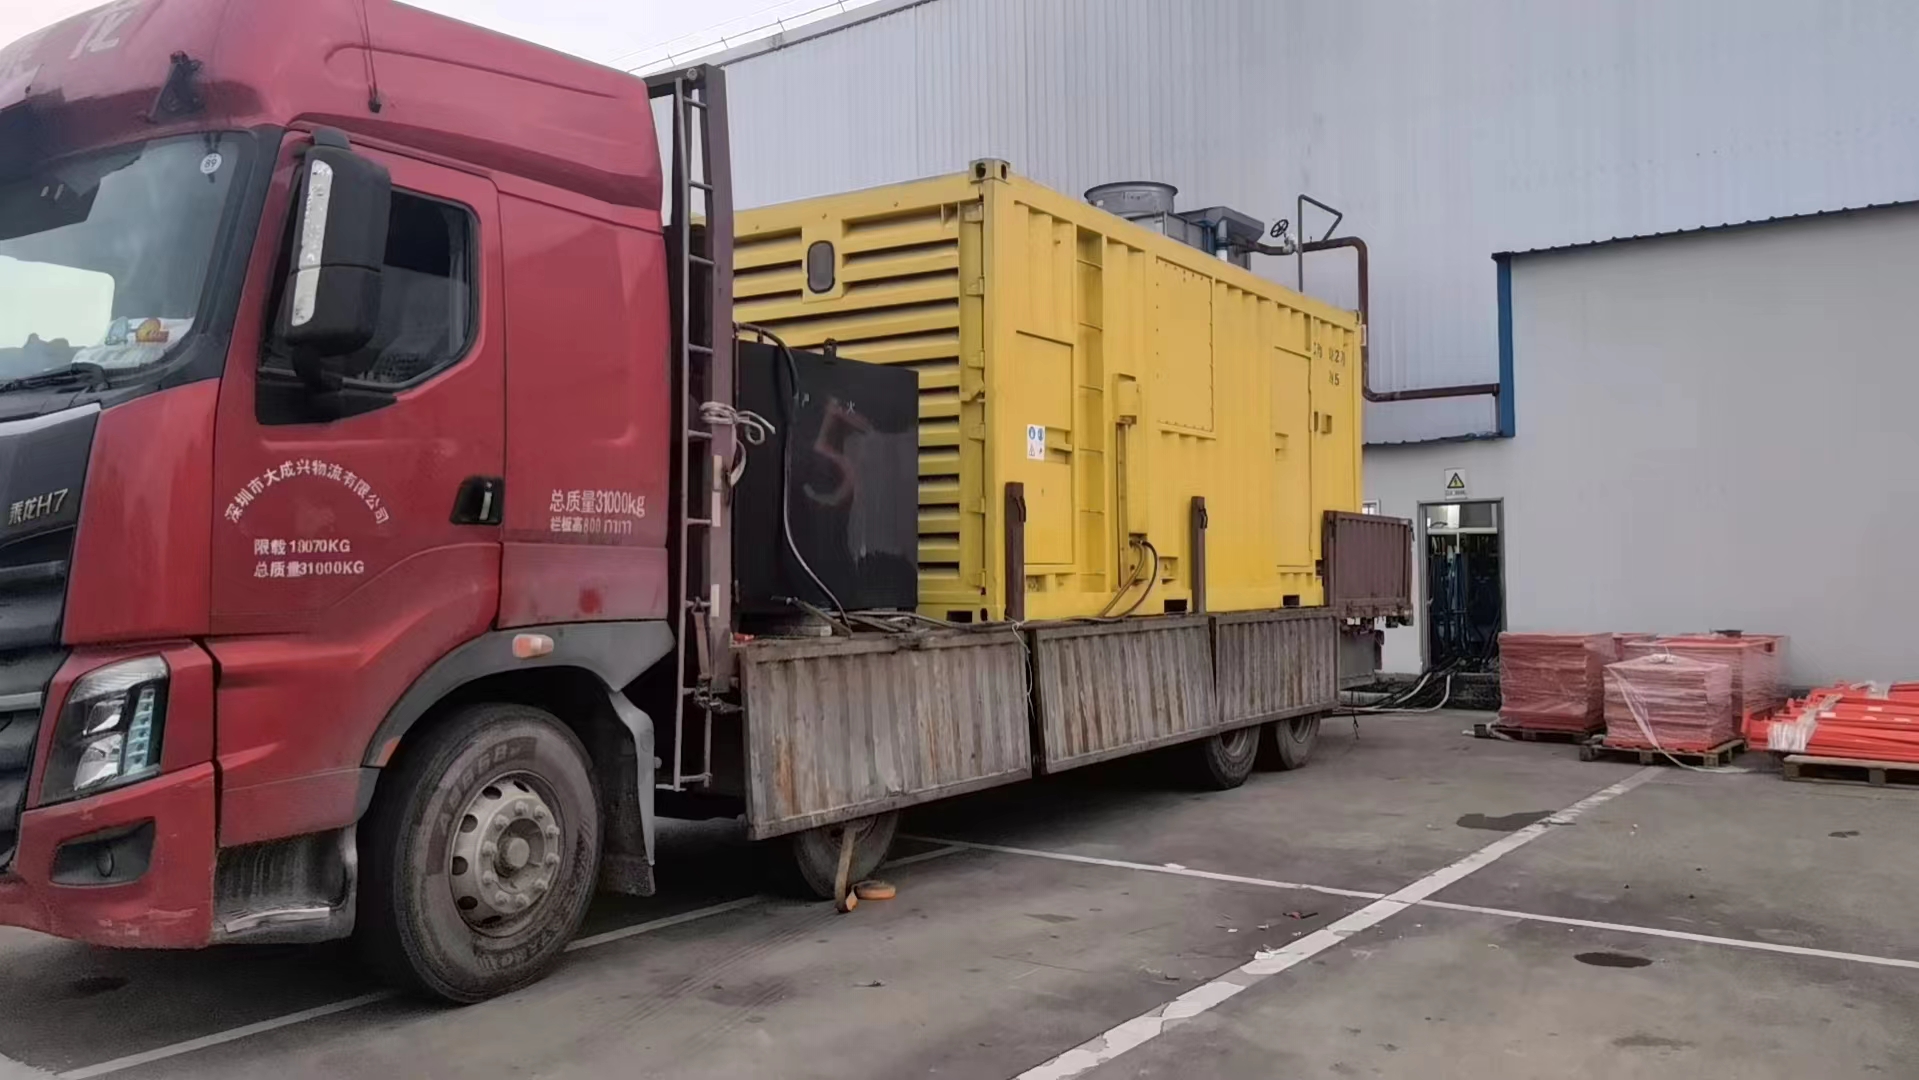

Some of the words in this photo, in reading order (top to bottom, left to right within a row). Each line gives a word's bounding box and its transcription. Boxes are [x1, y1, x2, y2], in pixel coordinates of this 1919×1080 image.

[224, 459, 389, 524] 深圳市大成兴物流有限公司
